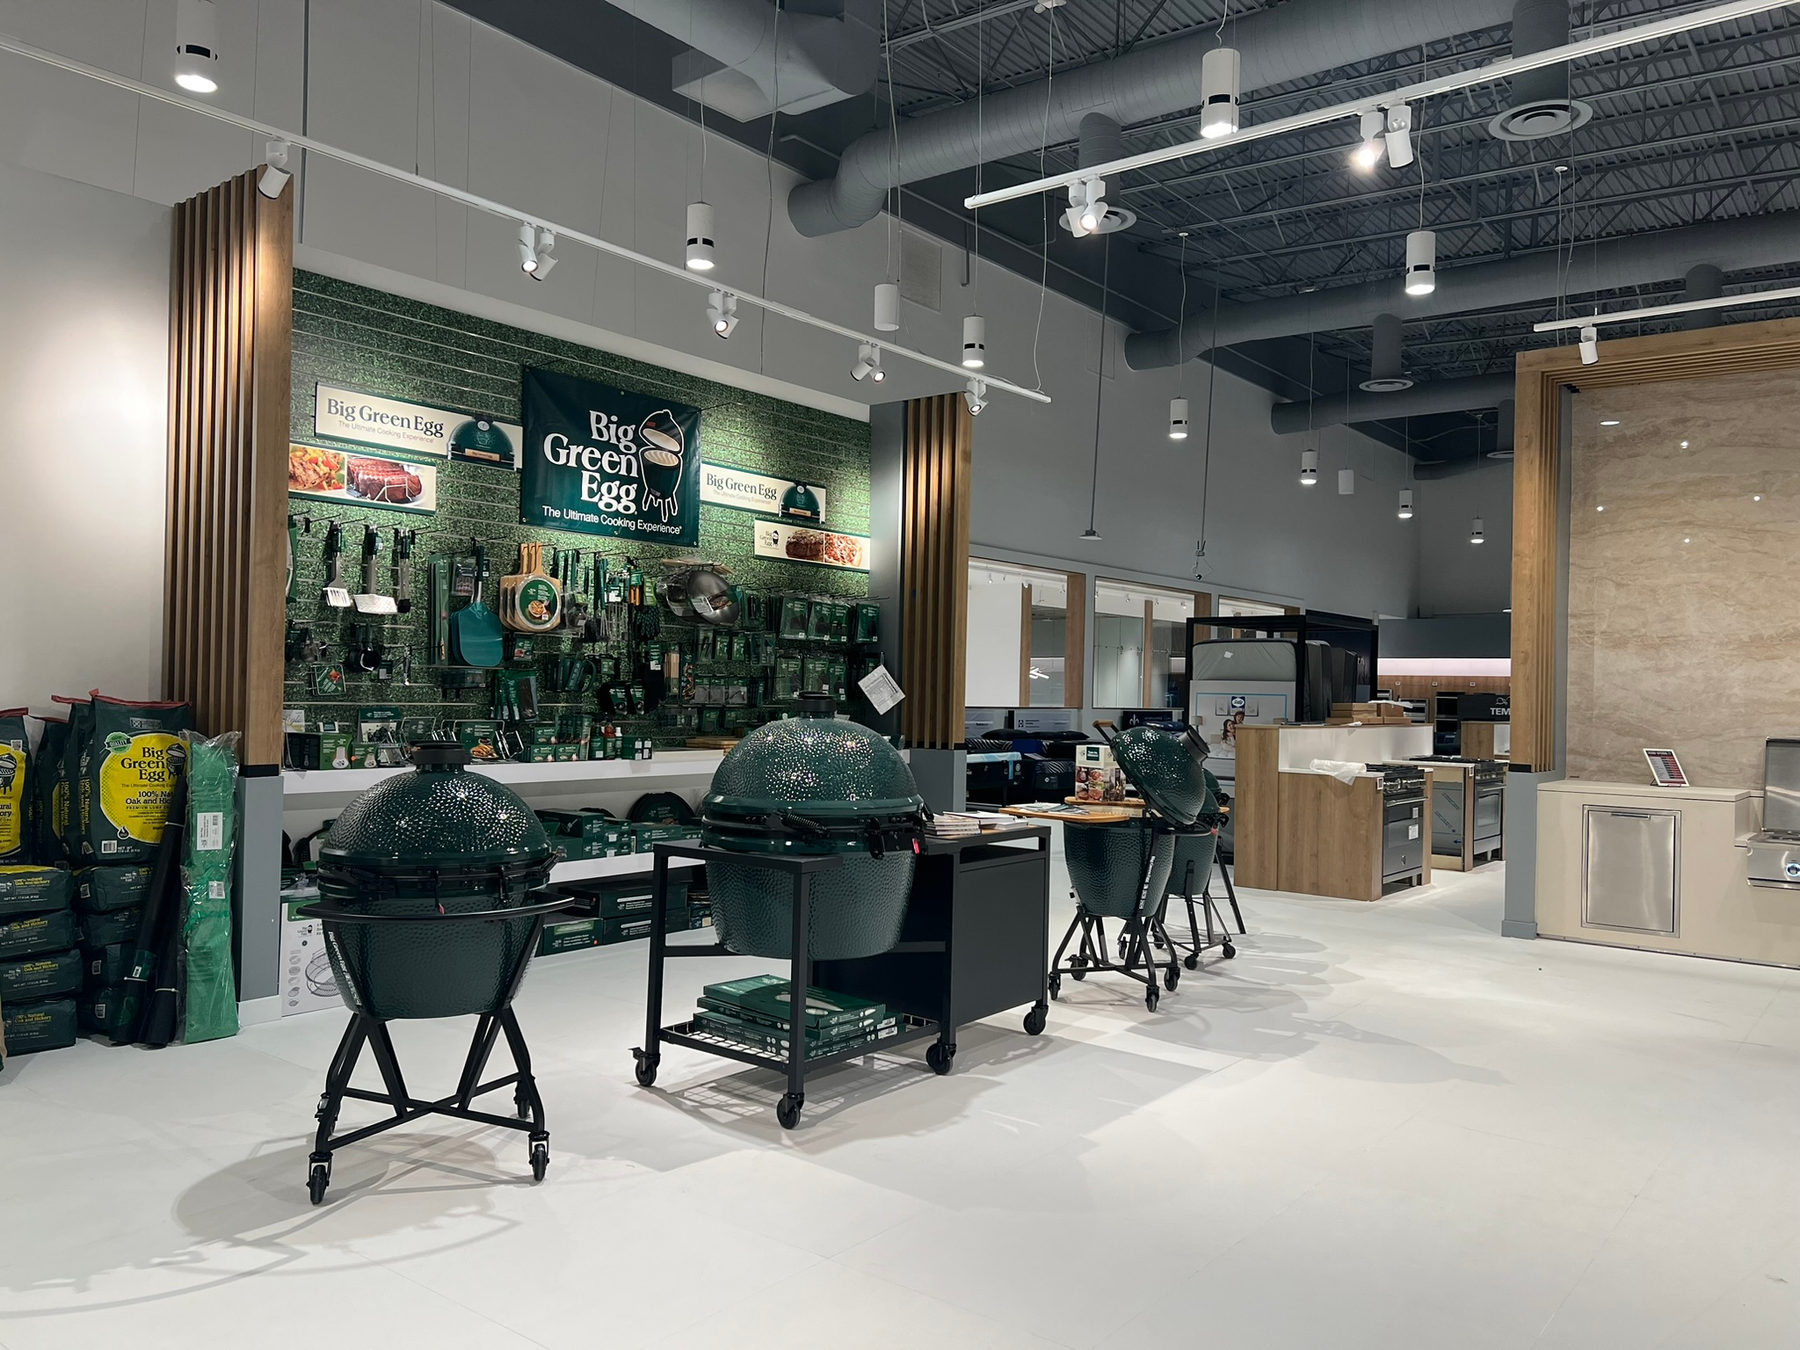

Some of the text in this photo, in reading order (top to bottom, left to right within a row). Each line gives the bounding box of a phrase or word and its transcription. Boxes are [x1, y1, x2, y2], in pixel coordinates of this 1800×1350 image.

[328, 398, 444, 438] Big Green Egg
[589, 410, 637, 454] Big
[352, 423, 376, 433] Ultimate
[377, 427, 401, 438] Cooking
[403, 432, 434, 443] Experience
[543, 433, 638, 478] Green
[580, 470, 638, 515] Egg
[706, 473, 777, 500] Big Green Egg
[542, 505, 682, 535] The Ultimate Cooking Experience
[121, 758, 165, 769] Green
[142, 747, 164, 760] Big
[139, 770, 166, 782] Egg
